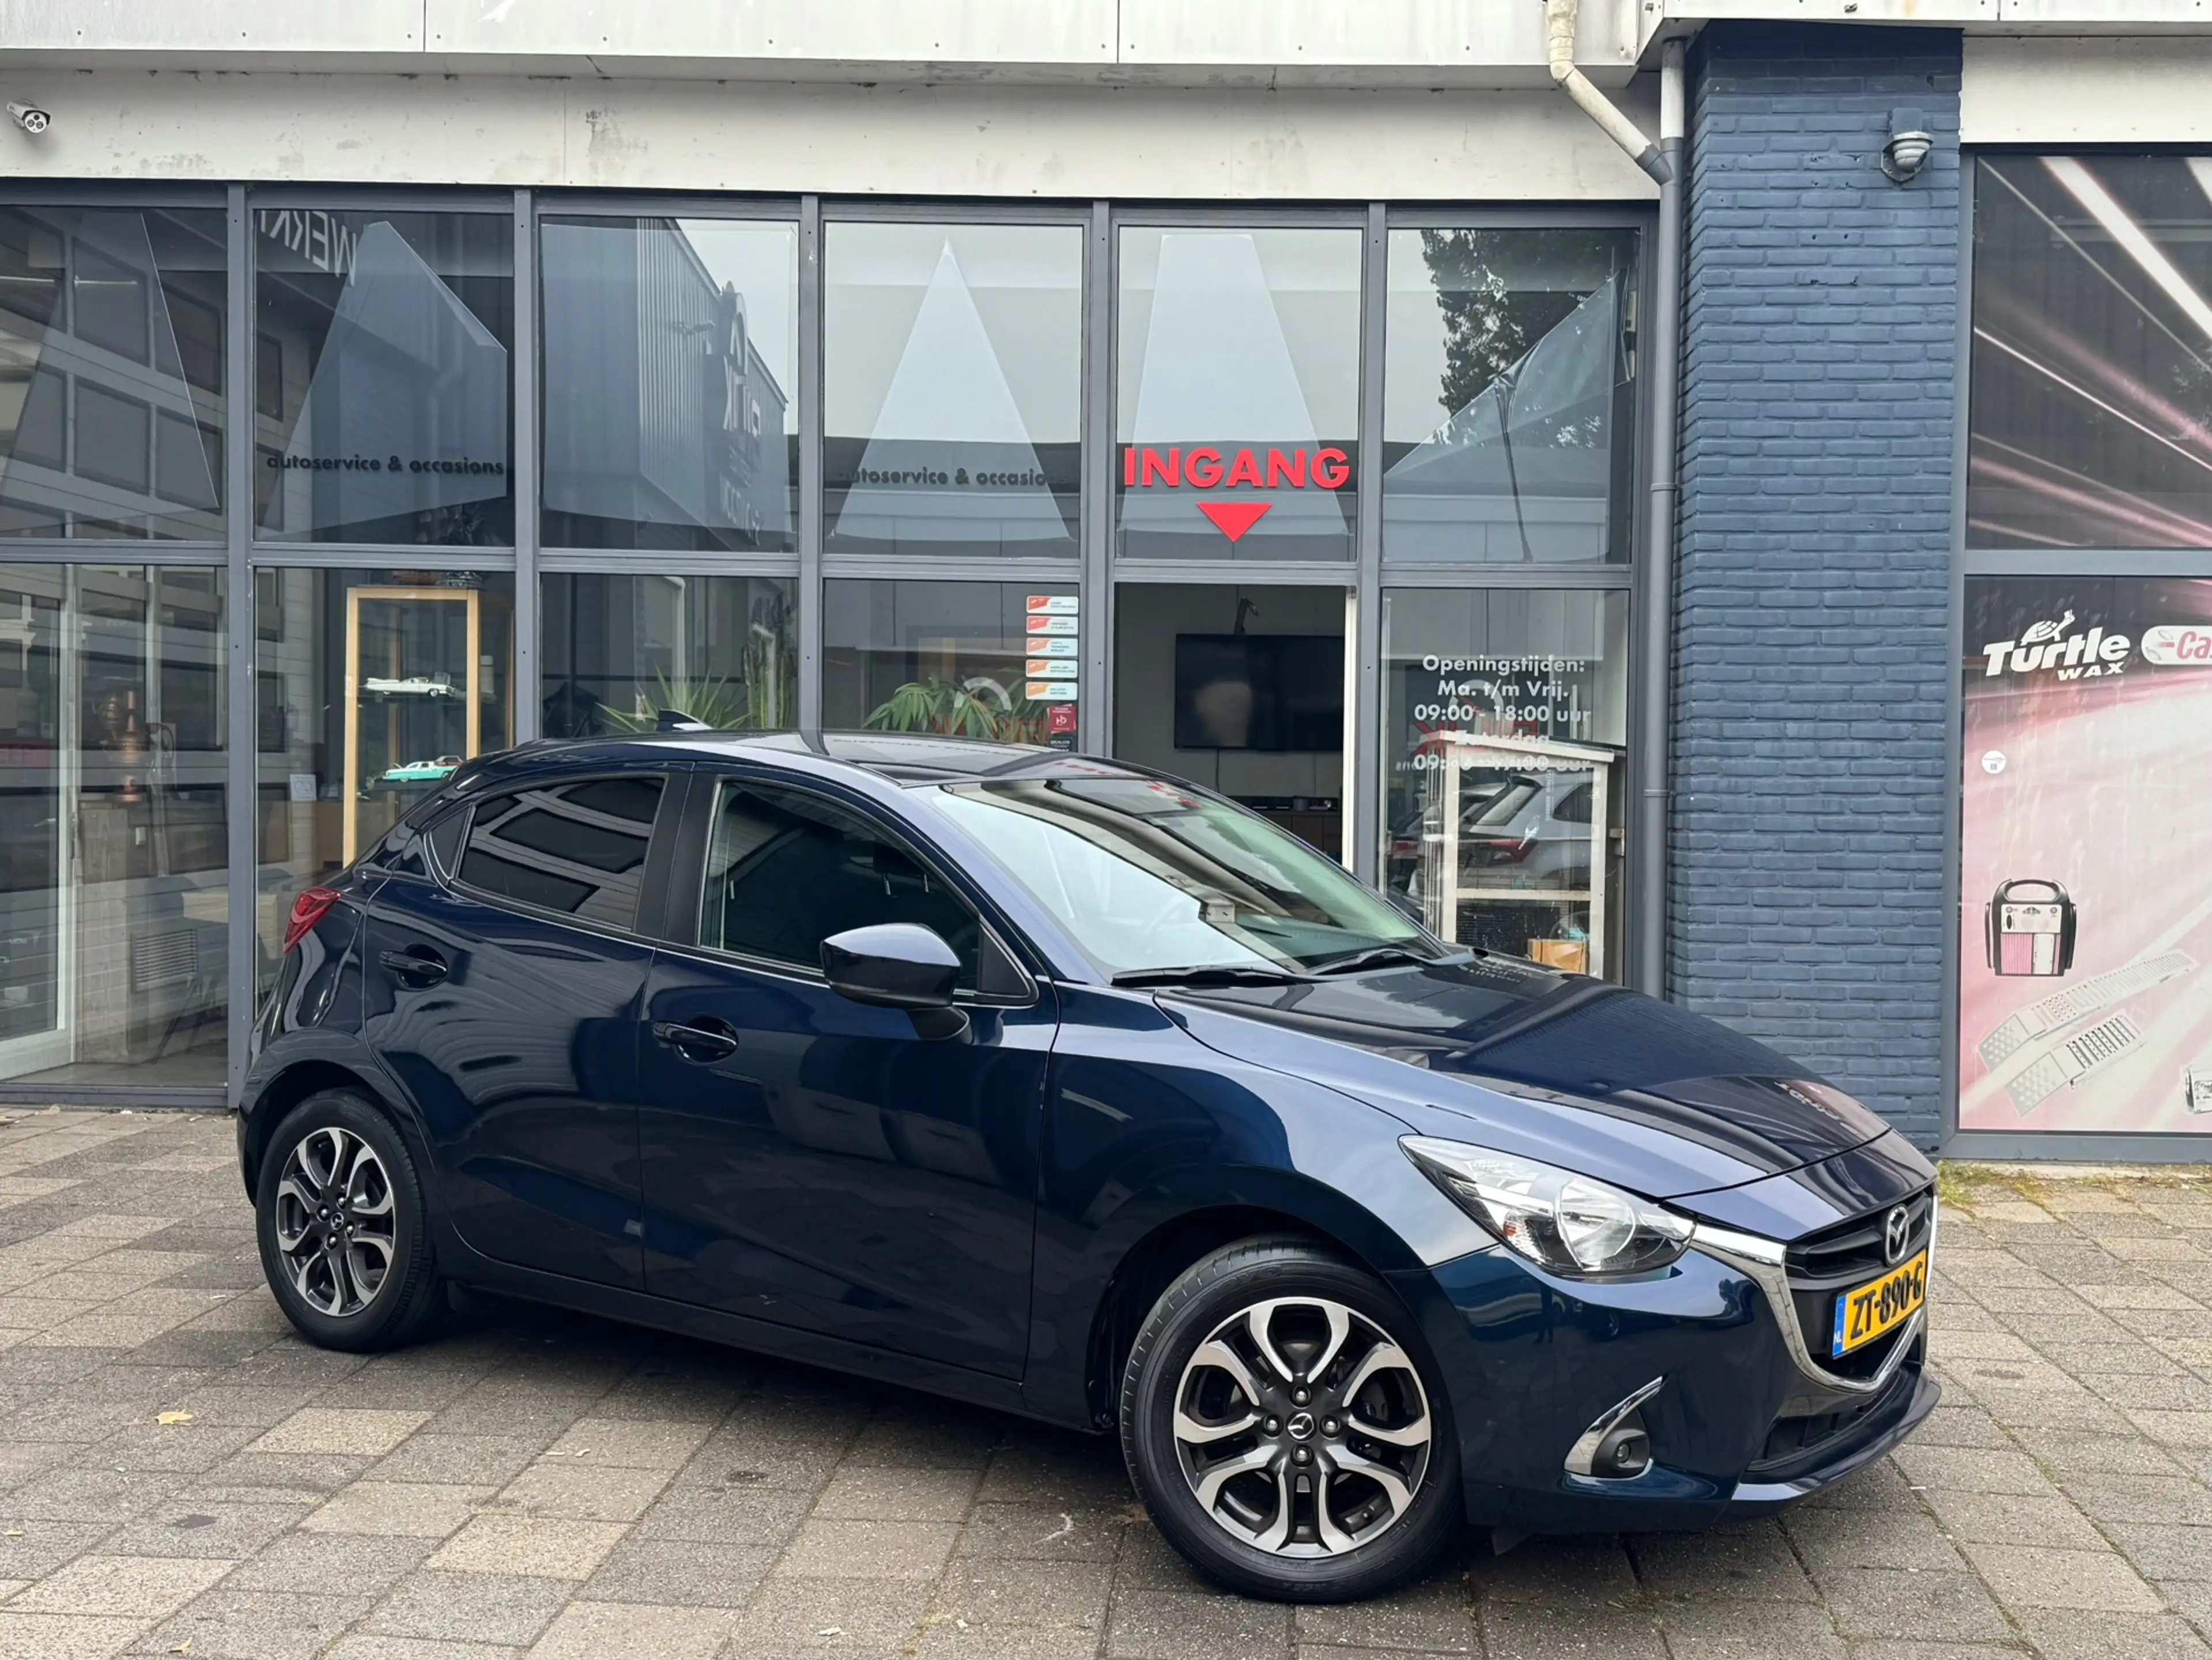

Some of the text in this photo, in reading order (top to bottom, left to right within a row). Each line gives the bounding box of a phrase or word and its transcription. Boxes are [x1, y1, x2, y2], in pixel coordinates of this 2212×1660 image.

[267, 454, 505, 476] autoservice & occasions
[1124, 447, 1350, 489] INGANG
[954, 468, 970, 485] &
[1982, 627, 2131, 677] Turtle
[1422, 654, 1585, 677] Openingstijden:
[2057, 661, 2124, 682] WAX
[1437, 679, 1569, 701] Ma. t/m Vrij.
[1414, 704, 1475, 722] 09:00
[1493, 705, 1550, 722] 18:00
[1557, 710, 1591, 722] uur
[1850, 1261, 1923, 1341] ZT-890-G
[1833, 1331, 1842, 1345] NL
